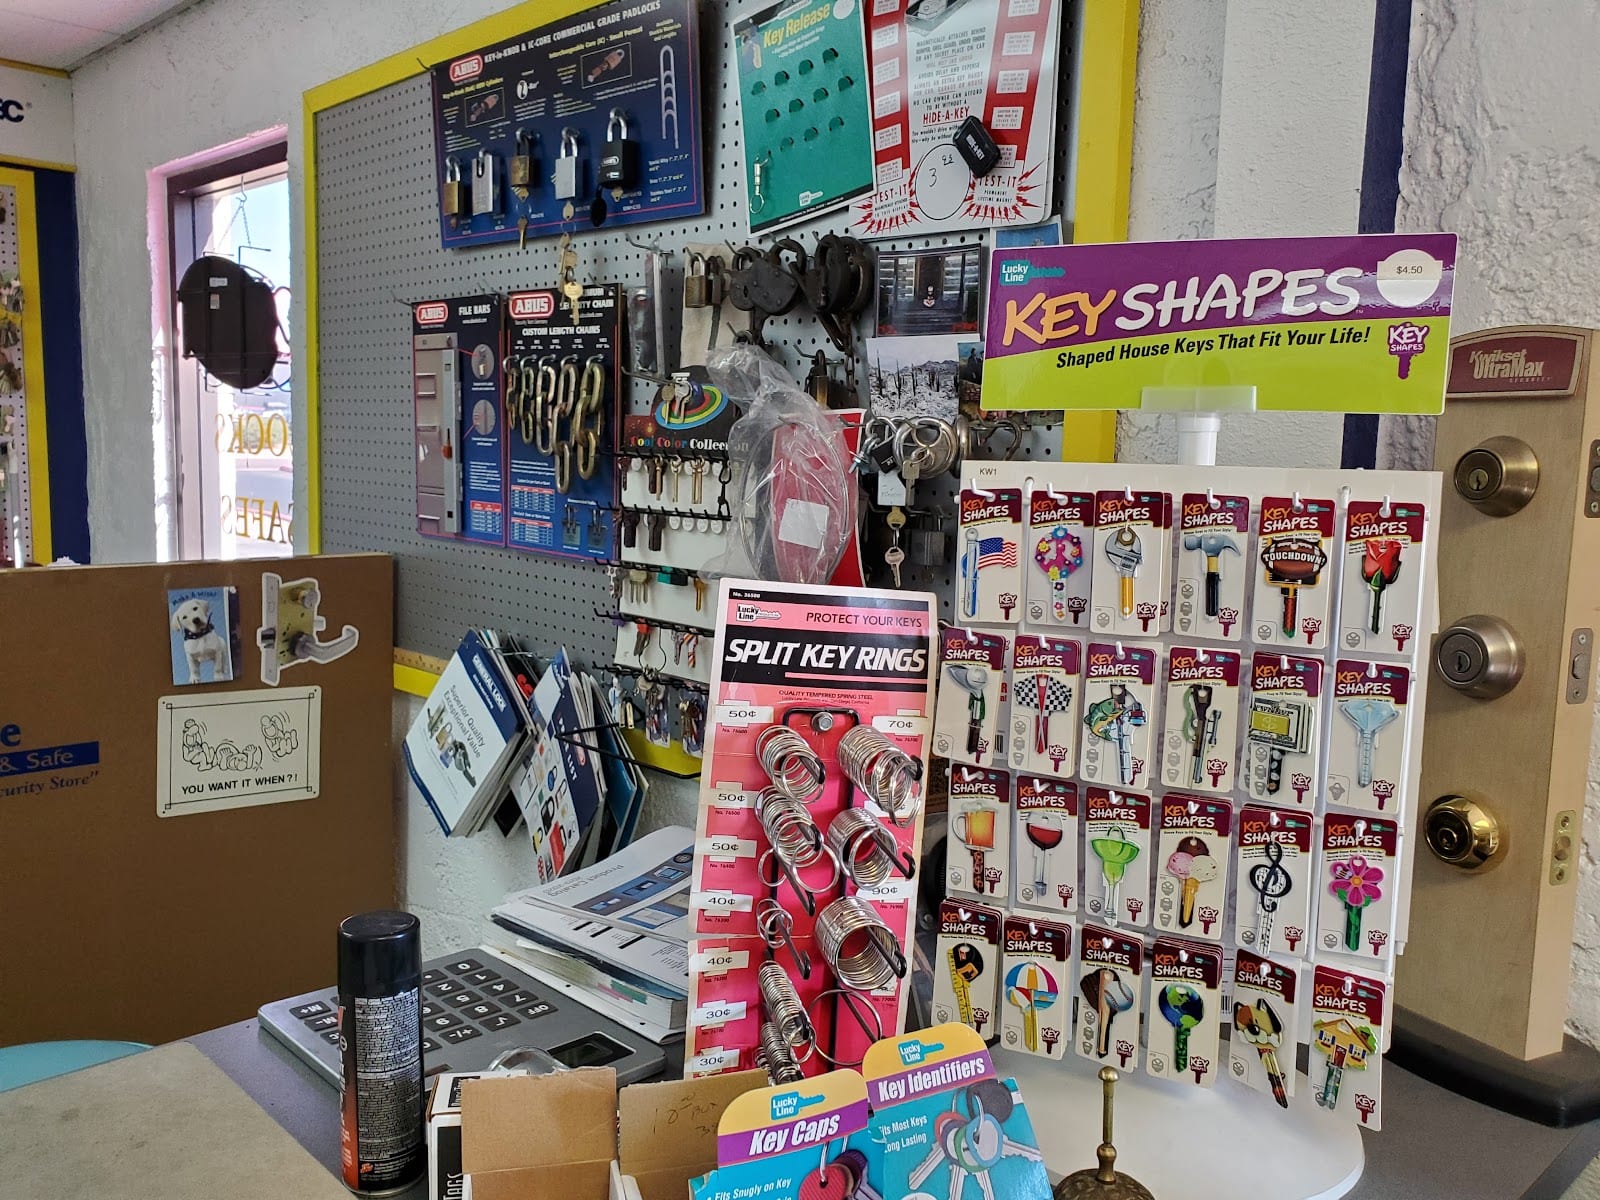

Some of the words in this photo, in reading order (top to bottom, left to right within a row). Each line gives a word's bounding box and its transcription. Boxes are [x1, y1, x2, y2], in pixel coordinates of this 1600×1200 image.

[553, 22, 595, 40] COMMERCIAL
[597, 13, 620, 27] GRADE
[623, 1, 660, 20] PADLOCKS
[764, 27, 784, 48] Key
[786, 3, 830, 37] Release
[454, 60, 478, 77] ABUS
[965, 89, 982, 97] AFFORD
[923, 106, 970, 124] HIDE-A-KEY
[929, 168, 937, 188] 3
[1002, 263, 1028, 276] Lucky
[1397, 265, 1422, 275] $4.50
[1005, 272, 1024, 282] Line
[515, 298, 549, 313] ABUS
[592, 299, 614, 308] CHAIN
[1002, 290, 1116, 346] KEY
[1115, 268, 1363, 330] SHAPES
[421, 308, 444, 319] ABUS
[459, 306, 471, 316] FILE
[474, 305, 490, 315] BARS
[549, 327, 574, 335] LENGTH
[576, 325, 600, 334] CHAINS
[1388, 325, 1428, 343] KEY
[1056, 346, 1115, 368] Shaped
[1120, 344, 1169, 361] House
[1174, 338, 1214, 356] Keys
[1218, 334, 1254, 350] That
[1259, 331, 1281, 347] Fit
[1286, 329, 1324, 346] Your
[1329, 327, 1371, 344] Life!
[1390, 344, 1424, 352] SHAPES
[1469, 349, 1527, 363] Kwikset
[1473, 357, 1544, 379] UltraMax
[979, 468, 997, 476] KW1
[963, 500, 986, 511] KEY
[1033, 501, 1055, 511] KEY
[1100, 500, 1122, 511] KEY
[1185, 503, 1208, 515] KEY
[963, 505, 1009, 522] SHAPES
[1033, 508, 1081, 522] SHAPES
[1099, 507, 1149, 523] SHAPES
[1184, 513, 1233, 526] SHAPES
[1264, 508, 1290, 520] KEY
[1350, 513, 1378, 525] KEY
[1263, 517, 1318, 532] SHAPES
[1350, 522, 1407, 537] SHAPES
[1262, 552, 1326, 566] TOUCHDOWN!
[738, 605, 759, 614] Lucky
[806, 612, 858, 624] PROTECT
[863, 616, 894, 625] YOUR
[896, 617, 922, 627] KEYS
[947, 639, 968, 649] KEY
[725, 638, 800, 665] SPLIT
[800, 644, 854, 669] KEY
[855, 647, 926, 672] RINGS
[945, 649, 989, 660] SHAPES
[1016, 646, 1039, 656] KEY
[1016, 655, 1063, 666] SHAPES
[1091, 654, 1115, 665] KEY
[1173, 657, 1199, 668] KEY
[1090, 664, 1139, 676] SHAPES
[1172, 667, 1224, 679] SHAPES
[1255, 666, 1279, 677] KEY
[1255, 676, 1304, 689] SHAPES
[1337, 672, 1364, 683] KEY
[1336, 682, 1392, 695] SHAPES
[450, 685, 468, 720] Superior
[467, 718, 487, 747] Quality
[728, 710, 756, 718] 50¢
[443, 691, 468, 733] Exceptional
[467, 735, 481, 757] Value
[0, 759, 17, 770] &
[27, 750, 74, 769] Safe
[50, 771, 99, 789] Store"
[182, 783, 204, 795] YOU
[208, 780, 238, 792] WANT
[242, 778, 251, 788] IT
[255, 775, 285, 786] WHEN
[952, 784, 996, 794] SHAPES
[718, 794, 745, 802] 50¢
[1020, 796, 1065, 808] SHAPES
[1089, 798, 1110, 809] KEY
[1089, 809, 1136, 820] SHAPES
[1165, 805, 1188, 816] KEY
[1164, 816, 1215, 828] SHAPES
[1243, 822, 1269, 832] KEY
[1328, 825, 1353, 835] KEY
[1243, 832, 1296, 843] SHAPES
[1328, 836, 1382, 847] SHAPES
[711, 843, 739, 851] 50¢
[598, 864, 624, 880] Product
[708, 897, 736, 905] 40¢
[942, 923, 986, 935] SHAPES
[1007, 930, 1029, 940] KEY
[1007, 941, 1053, 952] SHAPES
[707, 957, 733, 965] 40¢
[1086, 952, 1130, 965] SHAPES
[1155, 954, 1179, 965] KEY
[1154, 965, 1203, 979] SHAPES
[1238, 960, 1263, 973] KEY
[1238, 971, 1282, 991] SHAPES
[1315, 983, 1340, 996] KEY
[527, 1004, 549, 1015] OFF
[1315, 996, 1366, 1013] SHAPES
[706, 1009, 730, 1018] 30¢
[900, 1044, 921, 1055] Lucky
[700, 1057, 724, 1065] 30¢
[905, 1052, 920, 1063] Line
[878, 1080, 907, 1102] Key
[909, 1058, 986, 1091] Identifiers
[772, 1098, 798, 1110] Lucky
[775, 1106, 794, 1116] Line
[892, 1120, 909, 1134] Most
[911, 1115, 927, 1129] Keys
[749, 1129, 789, 1155] Key
[791, 1114, 840, 1144] Caps
[901, 1133, 927, 1149] Lasting
[715, 1192, 730, 1200] Fits
[733, 1184, 761, 1199] Snugly
[764, 1182, 774, 1192] on
[776, 1178, 791, 1189] Key
